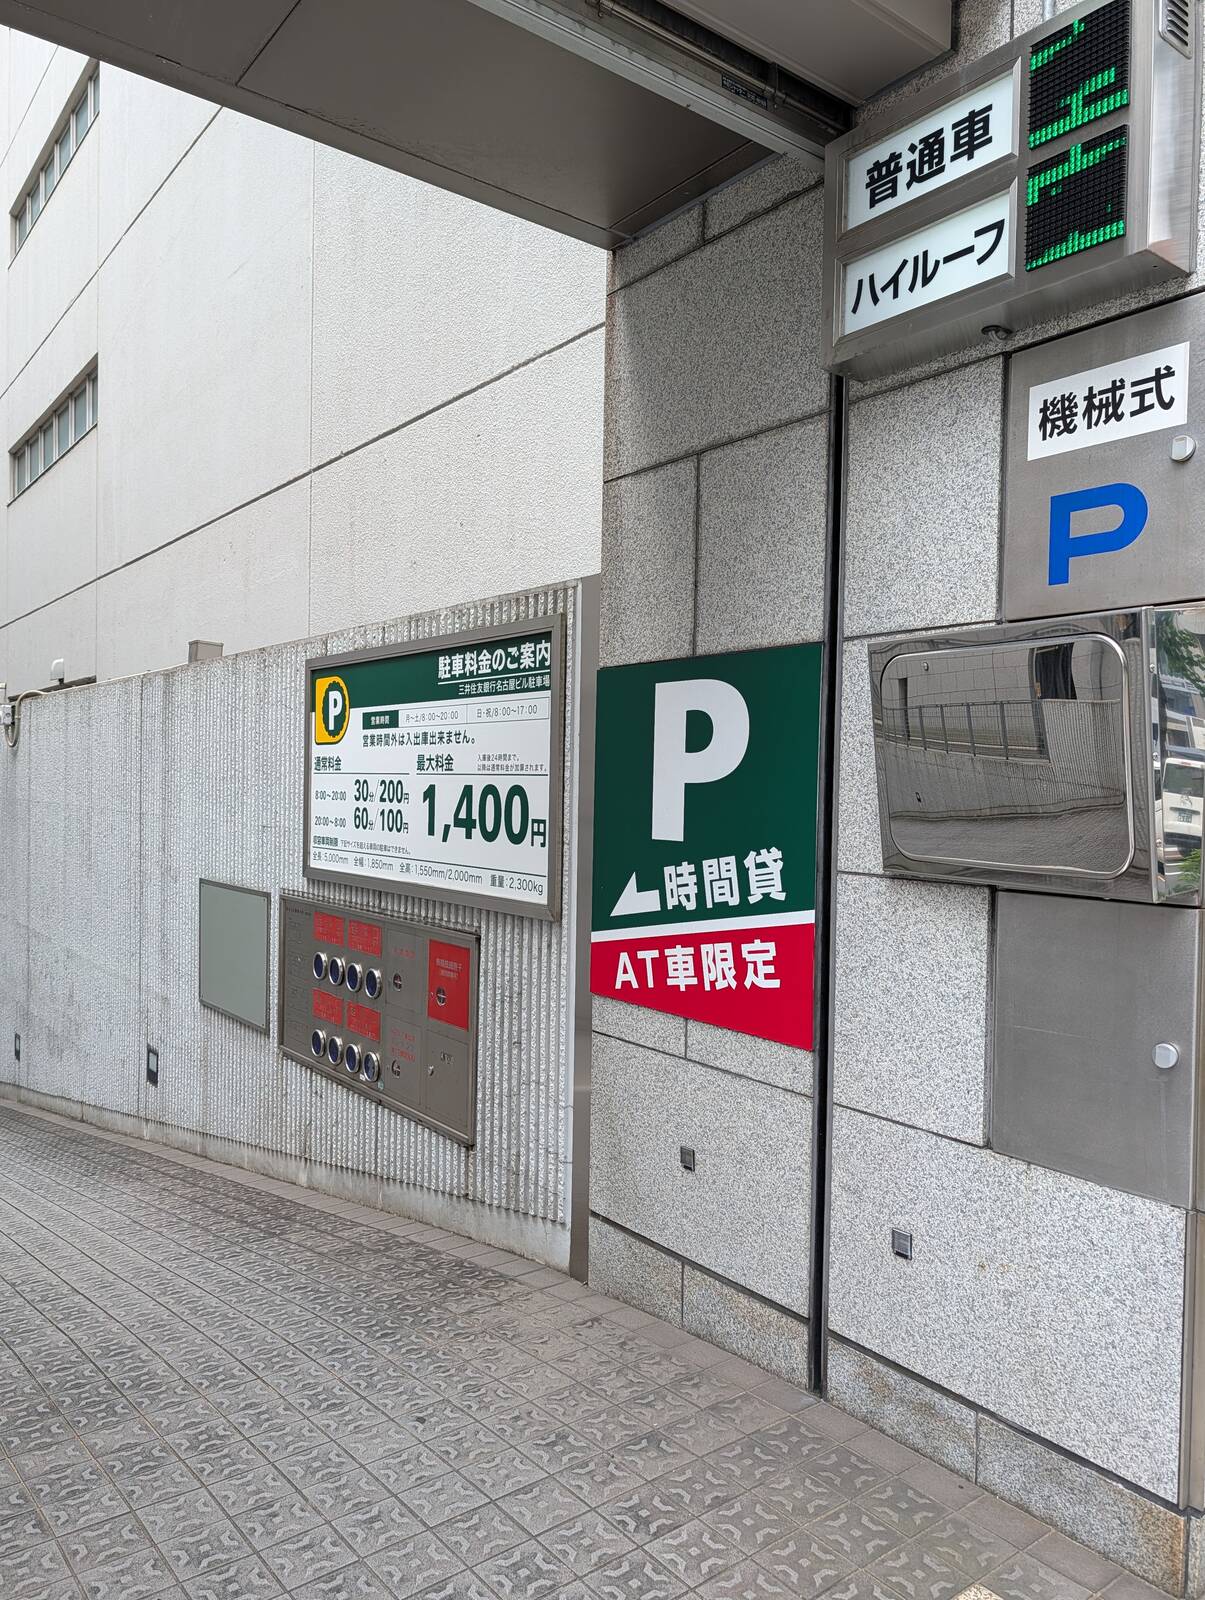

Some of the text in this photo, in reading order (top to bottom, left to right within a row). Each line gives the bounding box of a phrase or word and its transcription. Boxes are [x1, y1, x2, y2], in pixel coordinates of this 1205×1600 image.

[865, 103, 993, 210] 普通車
[851, 218, 1005, 314] ハイルーフ
[1038, 365, 1175, 441] 機械式
[1048, 482, 1149, 586] P
[438, 640, 551, 679] 駐車料金のご案内
[328, 690, 343, 731] P
[314, 754, 342, 772] 通常料金
[416, 753, 454, 772] 最大料金
[651, 678, 750, 842] P
[422, 783, 547, 848] 1,400円
[663, 846, 786, 912] 時間貸
[614, 938, 781, 992] AT車限定
